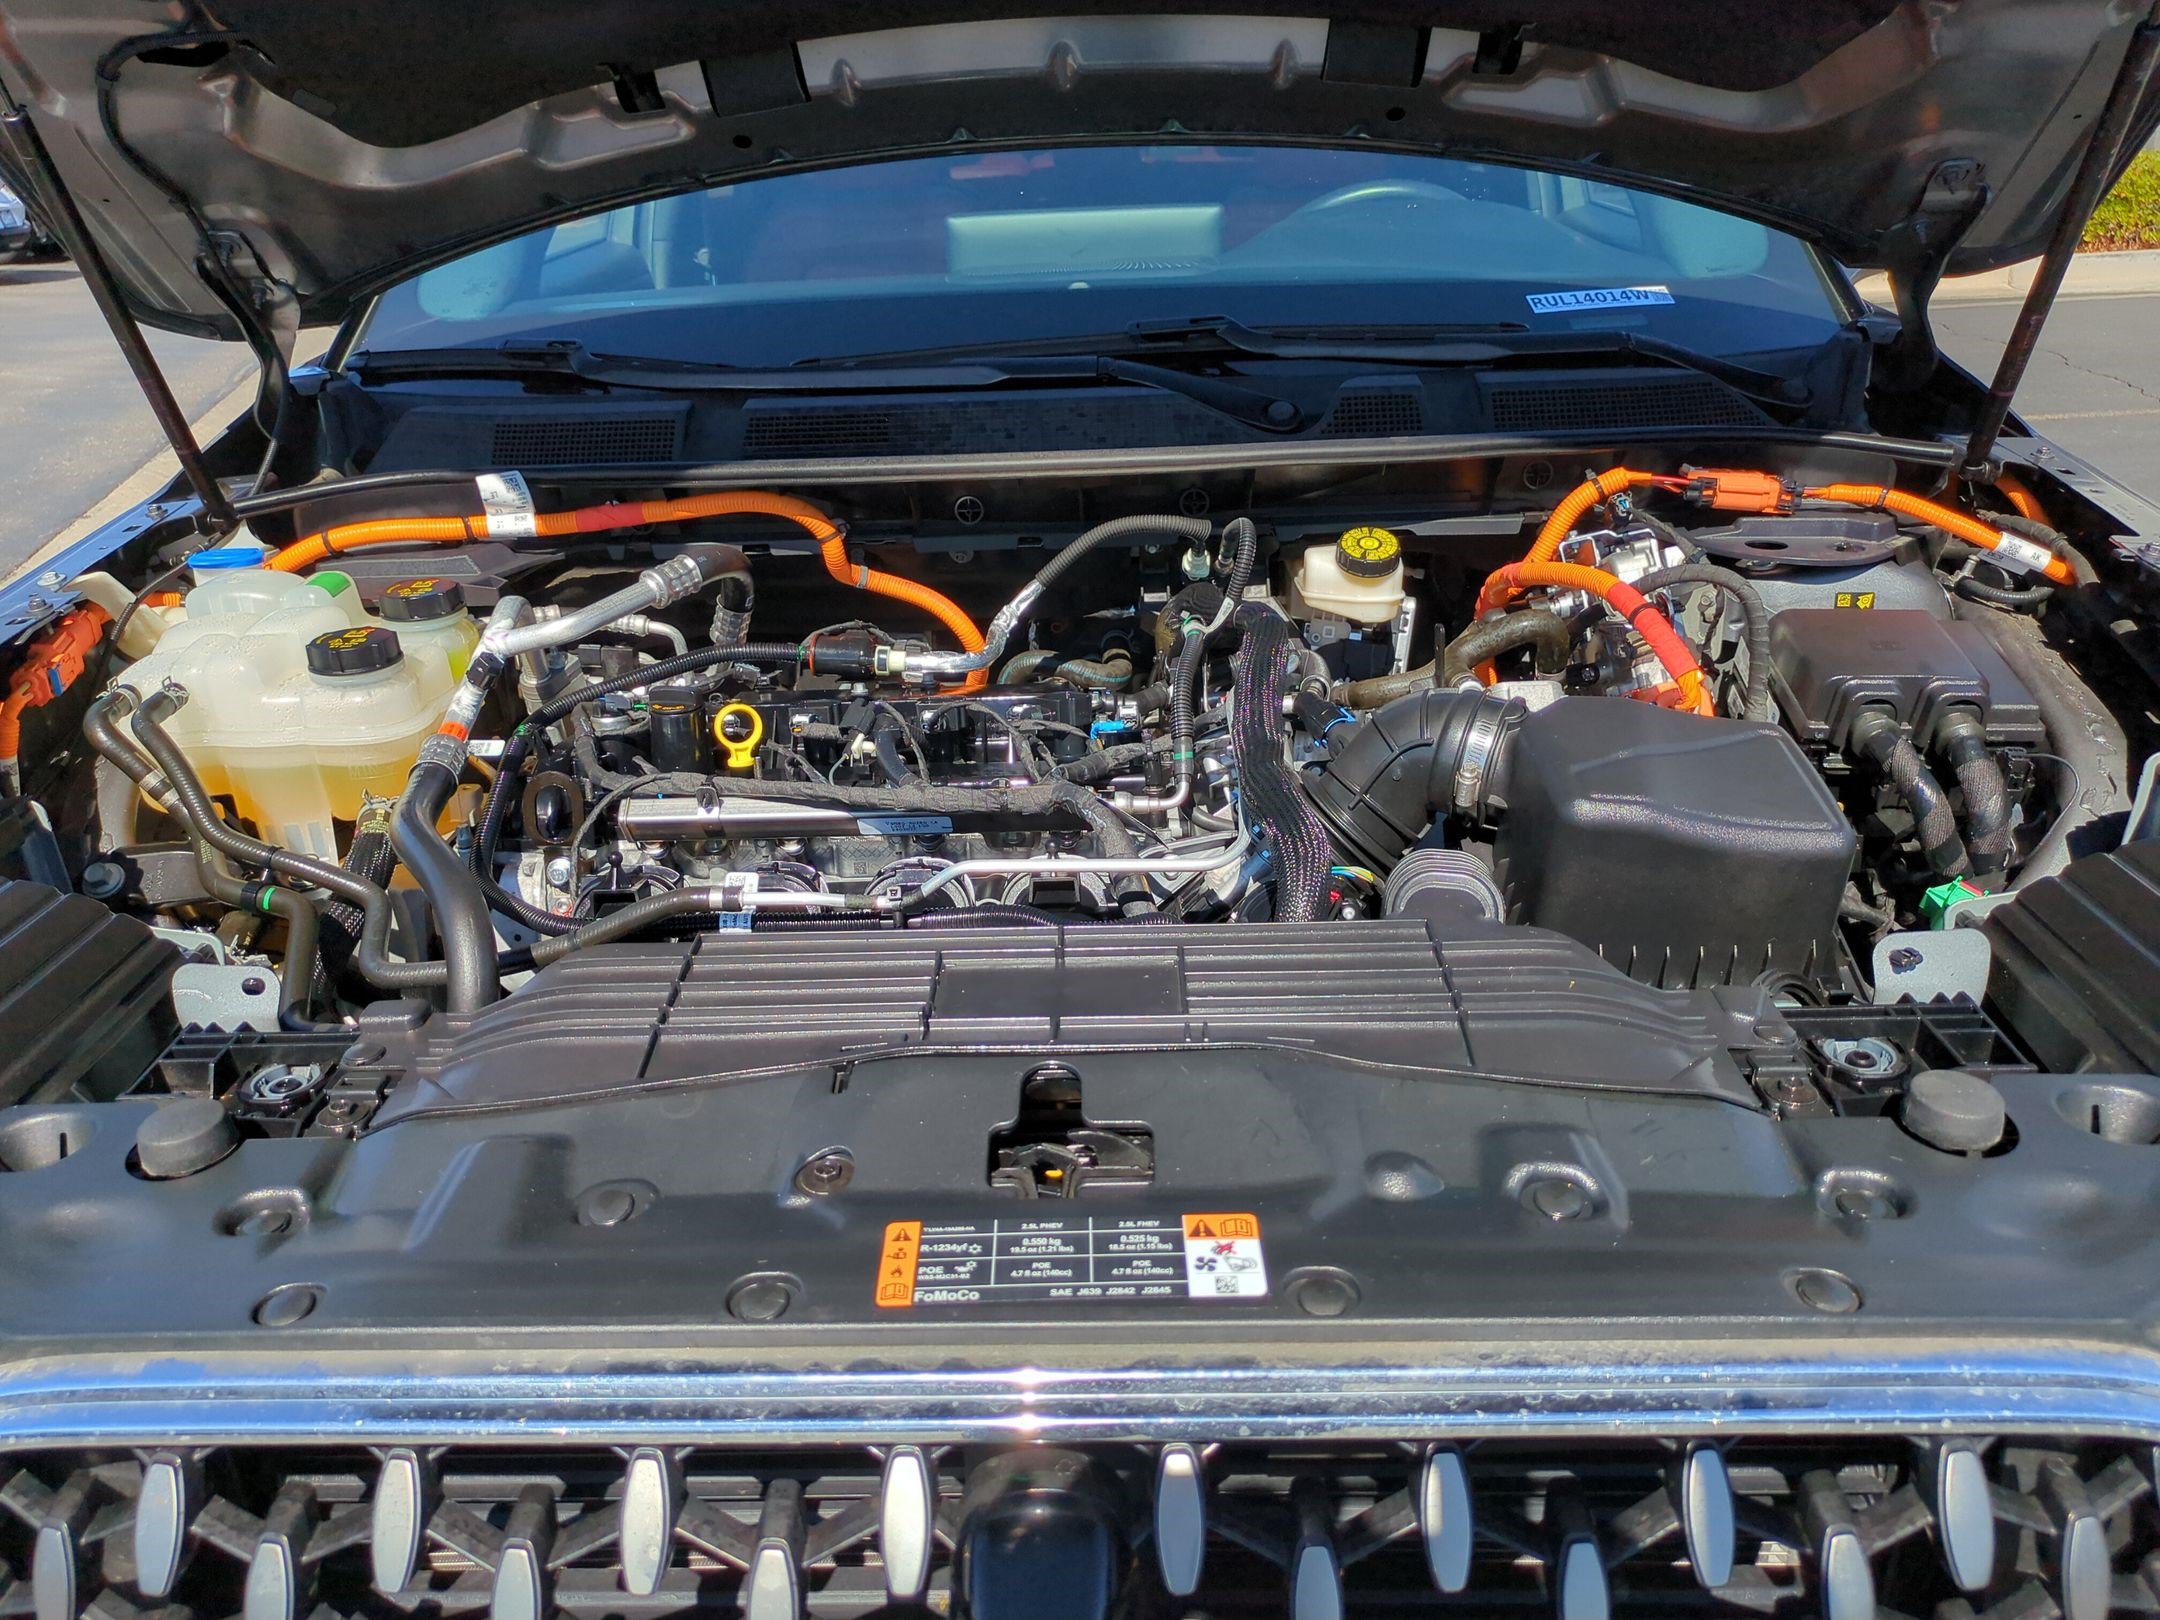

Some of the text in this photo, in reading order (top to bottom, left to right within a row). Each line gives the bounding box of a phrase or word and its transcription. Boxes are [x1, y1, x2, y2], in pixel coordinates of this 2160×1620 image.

[1530, 290, 1650, 308] RUL14014W
[1023, 1237, 1062, 1246] 0.550 kg
[1120, 1234, 1160, 1243] 0.525 kg
[920, 1243, 968, 1254] R-1234yf
[1038, 1245, 1057, 1254] (1.21
[1108, 1243, 1126, 1251] 18.5
[1136, 1243, 1156, 1251] (1.15
[919, 1266, 944, 1274] POE
[1042, 1269, 1073, 1278] (140cc)
[1111, 1267, 1125, 1275] 4.7
[1143, 1267, 1174, 1276] (140cc)
[914, 1290, 980, 1302] FoMoCo
[1049, 1287, 1073, 1297] SAE
[1077, 1286, 1102, 1297] J639
[1105, 1286, 1136, 1296] J2842
